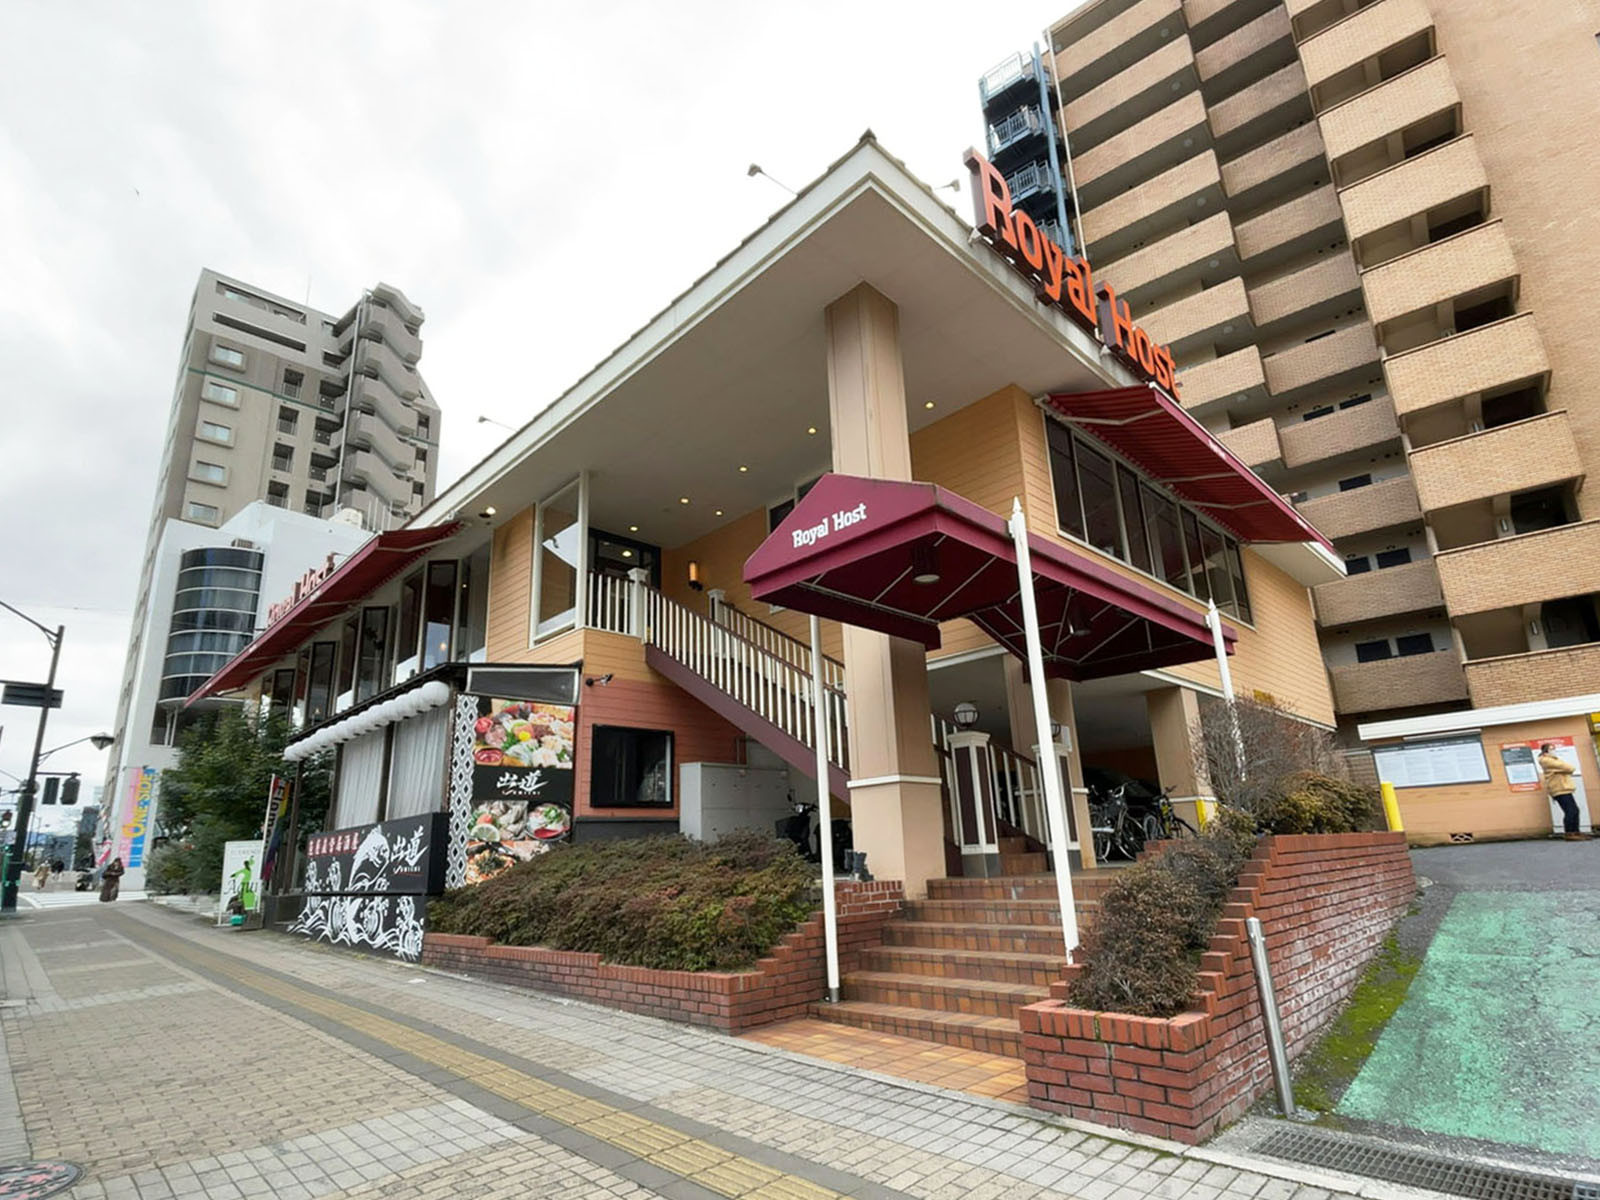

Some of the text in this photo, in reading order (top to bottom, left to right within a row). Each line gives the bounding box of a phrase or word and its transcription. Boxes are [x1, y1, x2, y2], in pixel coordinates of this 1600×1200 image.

[964, 147, 1180, 401] Royal Host
[792, 503, 867, 548] Royal Host
